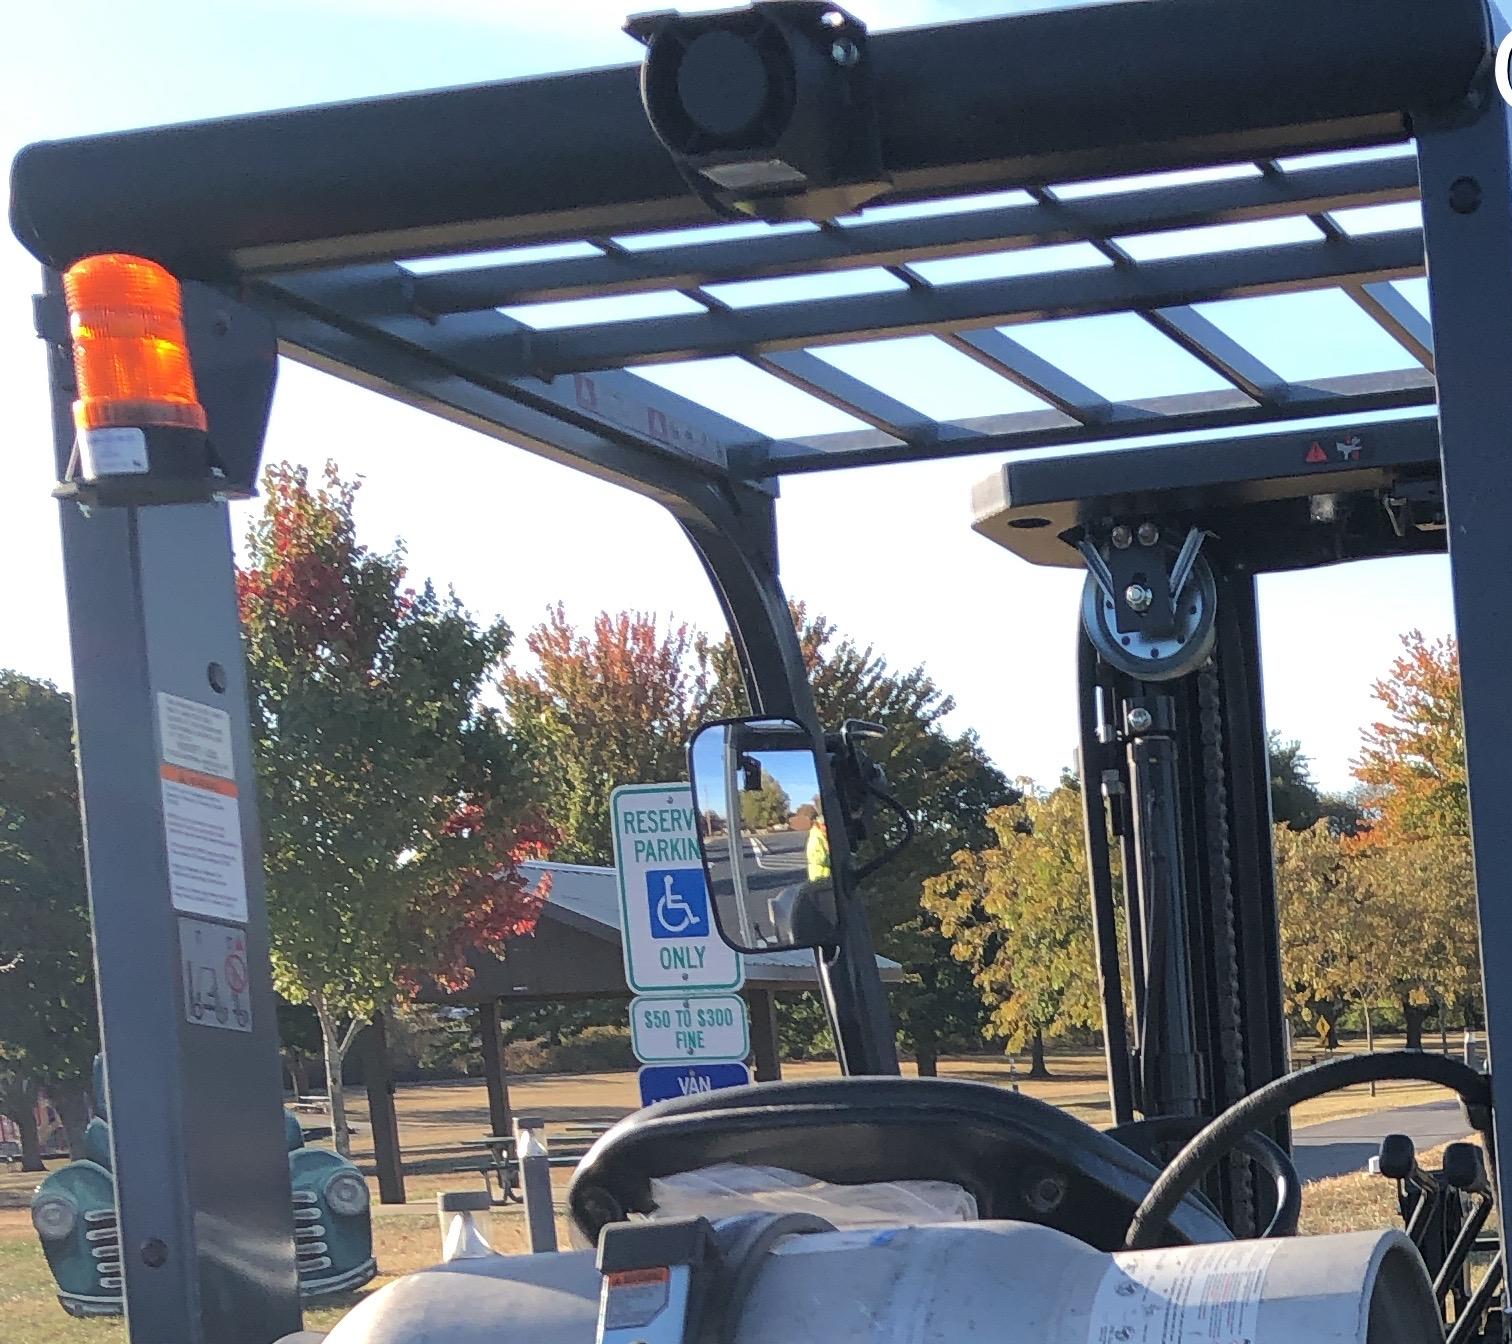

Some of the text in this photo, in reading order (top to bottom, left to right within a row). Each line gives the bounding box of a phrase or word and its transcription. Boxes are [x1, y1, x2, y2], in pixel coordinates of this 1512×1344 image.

[623, 808, 696, 834] RESERV
[634, 836, 702, 862] PARKIN
[660, 945, 706, 969] ONLY
[644, 1007, 734, 1029] $50 TO $300
[675, 1030, 705, 1049] FINE
[677, 1075, 711, 1096] VAN
